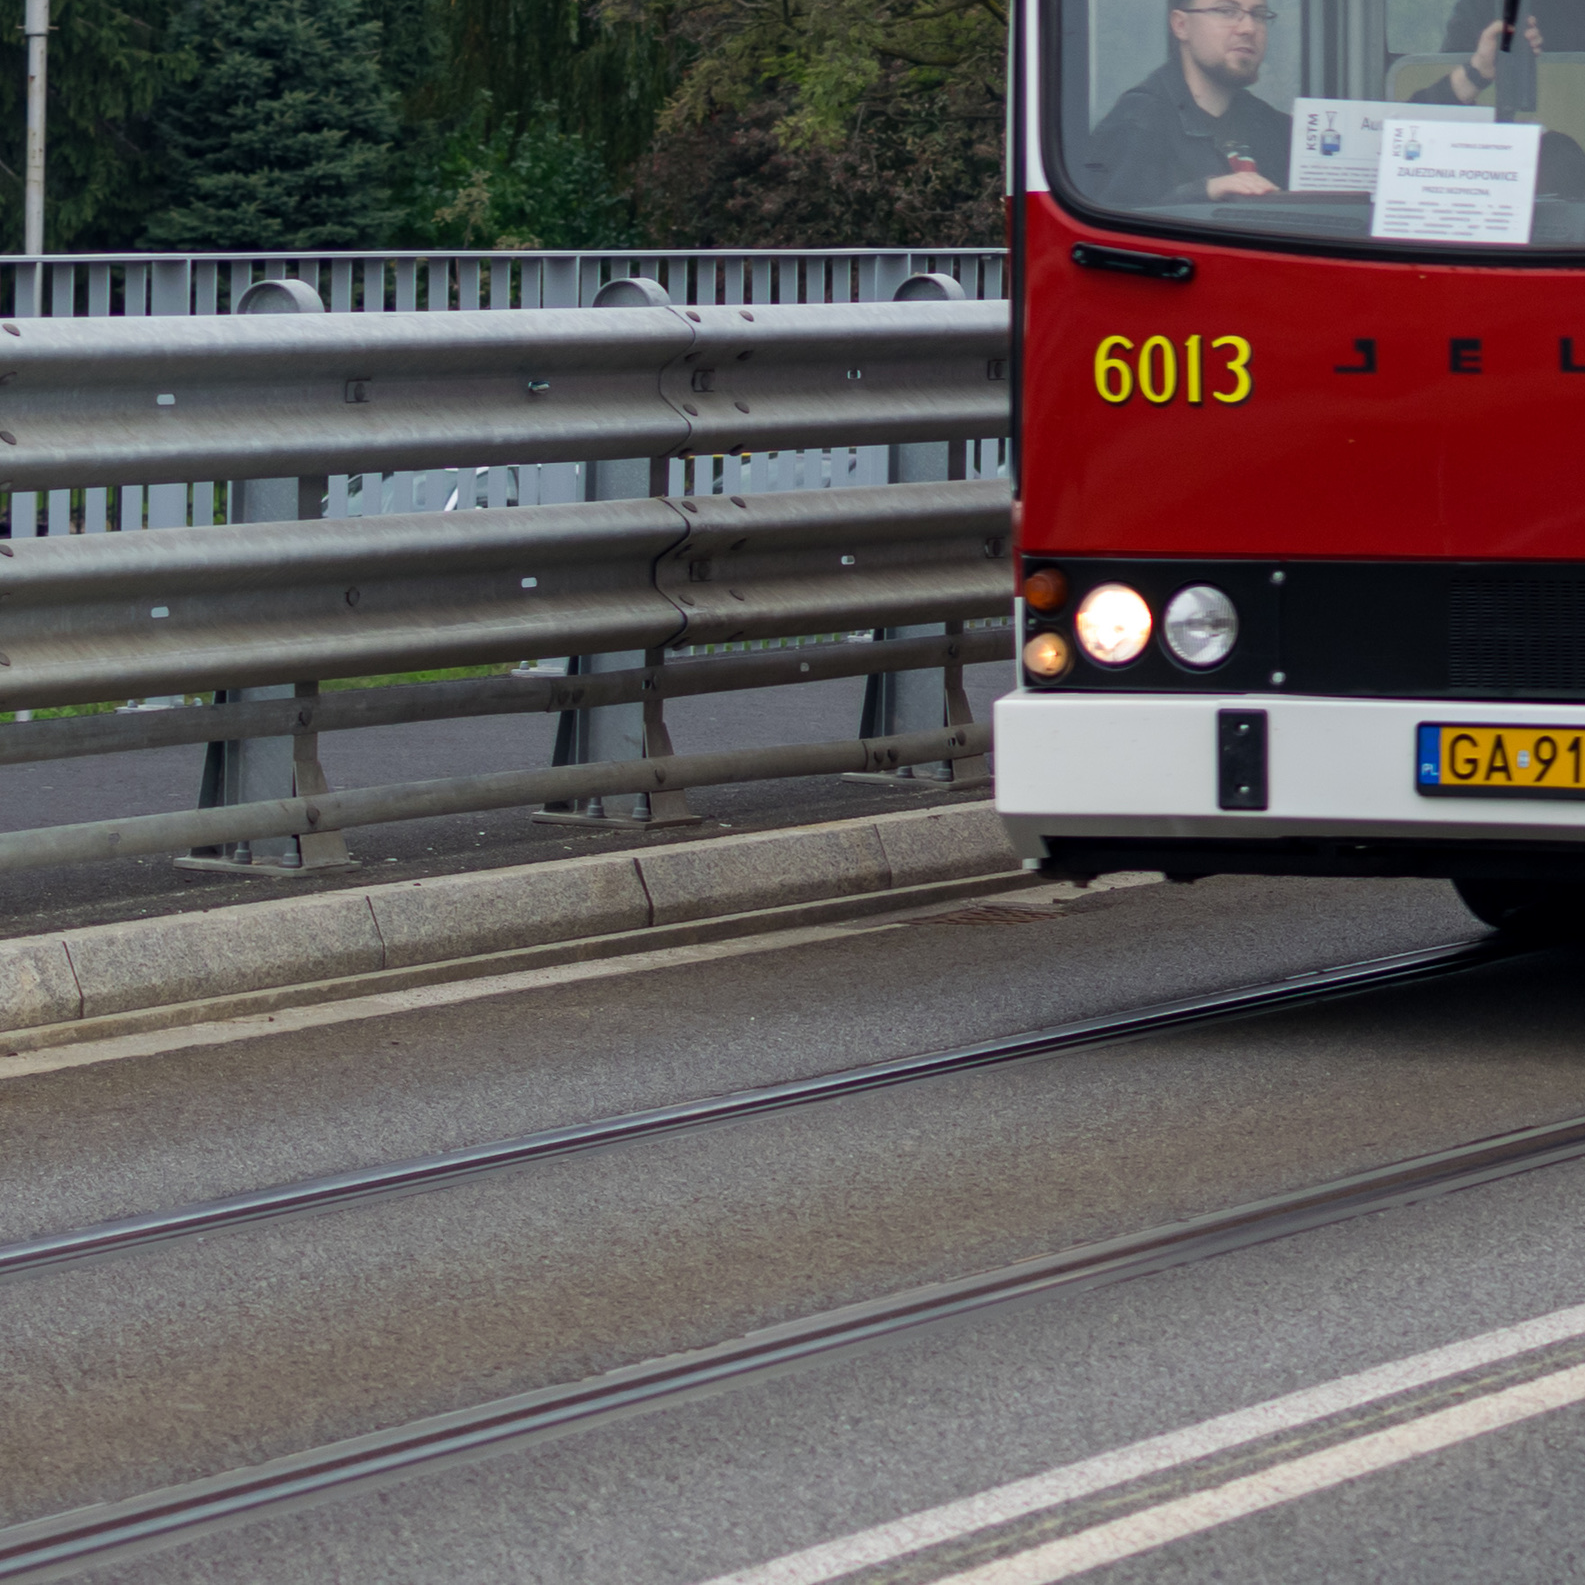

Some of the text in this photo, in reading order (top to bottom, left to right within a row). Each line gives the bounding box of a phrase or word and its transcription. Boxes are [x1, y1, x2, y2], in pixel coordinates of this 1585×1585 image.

[1305, 112, 1319, 151] KSTM
[1396, 166, 1456, 180] ZAJEZDNIA
[1459, 169, 1519, 183] POPOWICE
[1093, 333, 1254, 405] 6013
[1420, 763, 1440, 776] PL
[1448, 733, 1513, 782] GA
